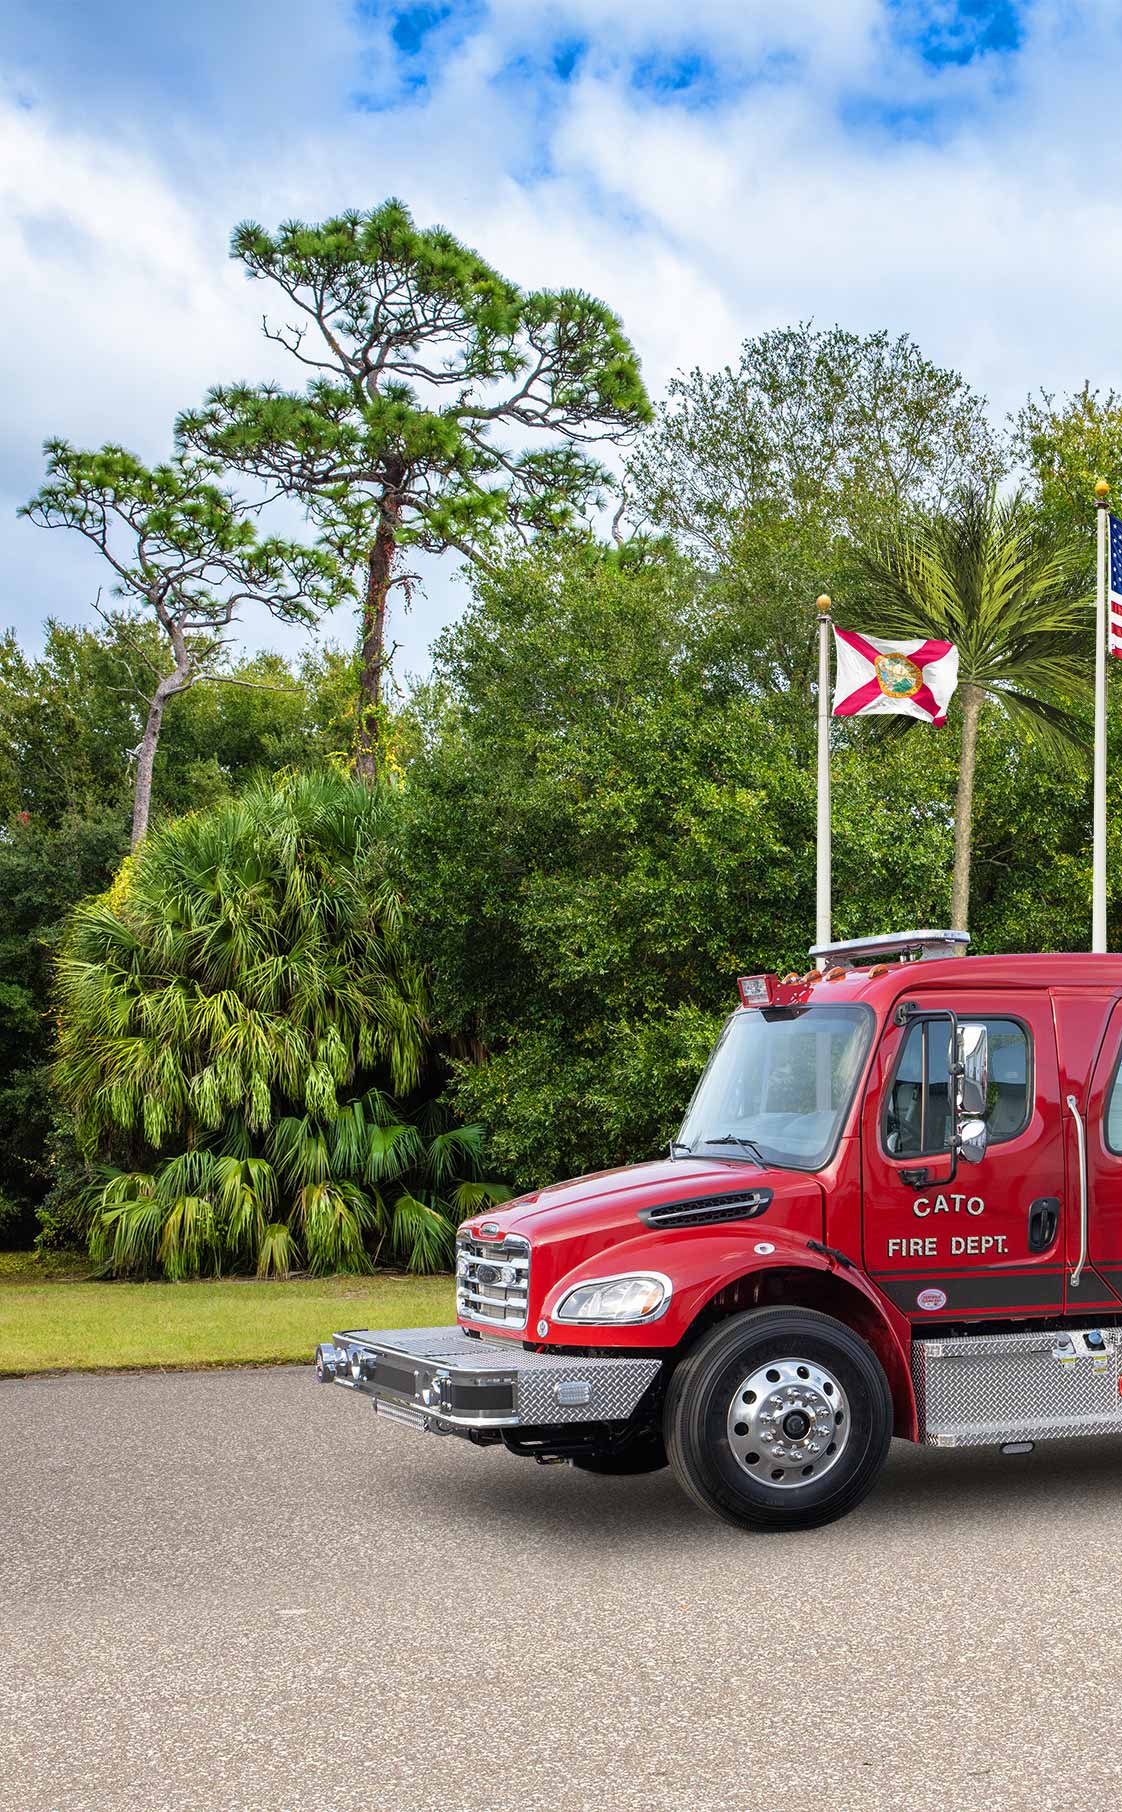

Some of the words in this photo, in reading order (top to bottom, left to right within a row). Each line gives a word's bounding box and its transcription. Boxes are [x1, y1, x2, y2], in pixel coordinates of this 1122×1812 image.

[913, 1194, 985, 1217] CATO
[888, 1238, 937, 1257] FIRE
[951, 1236, 1009, 1255] DEPT.
